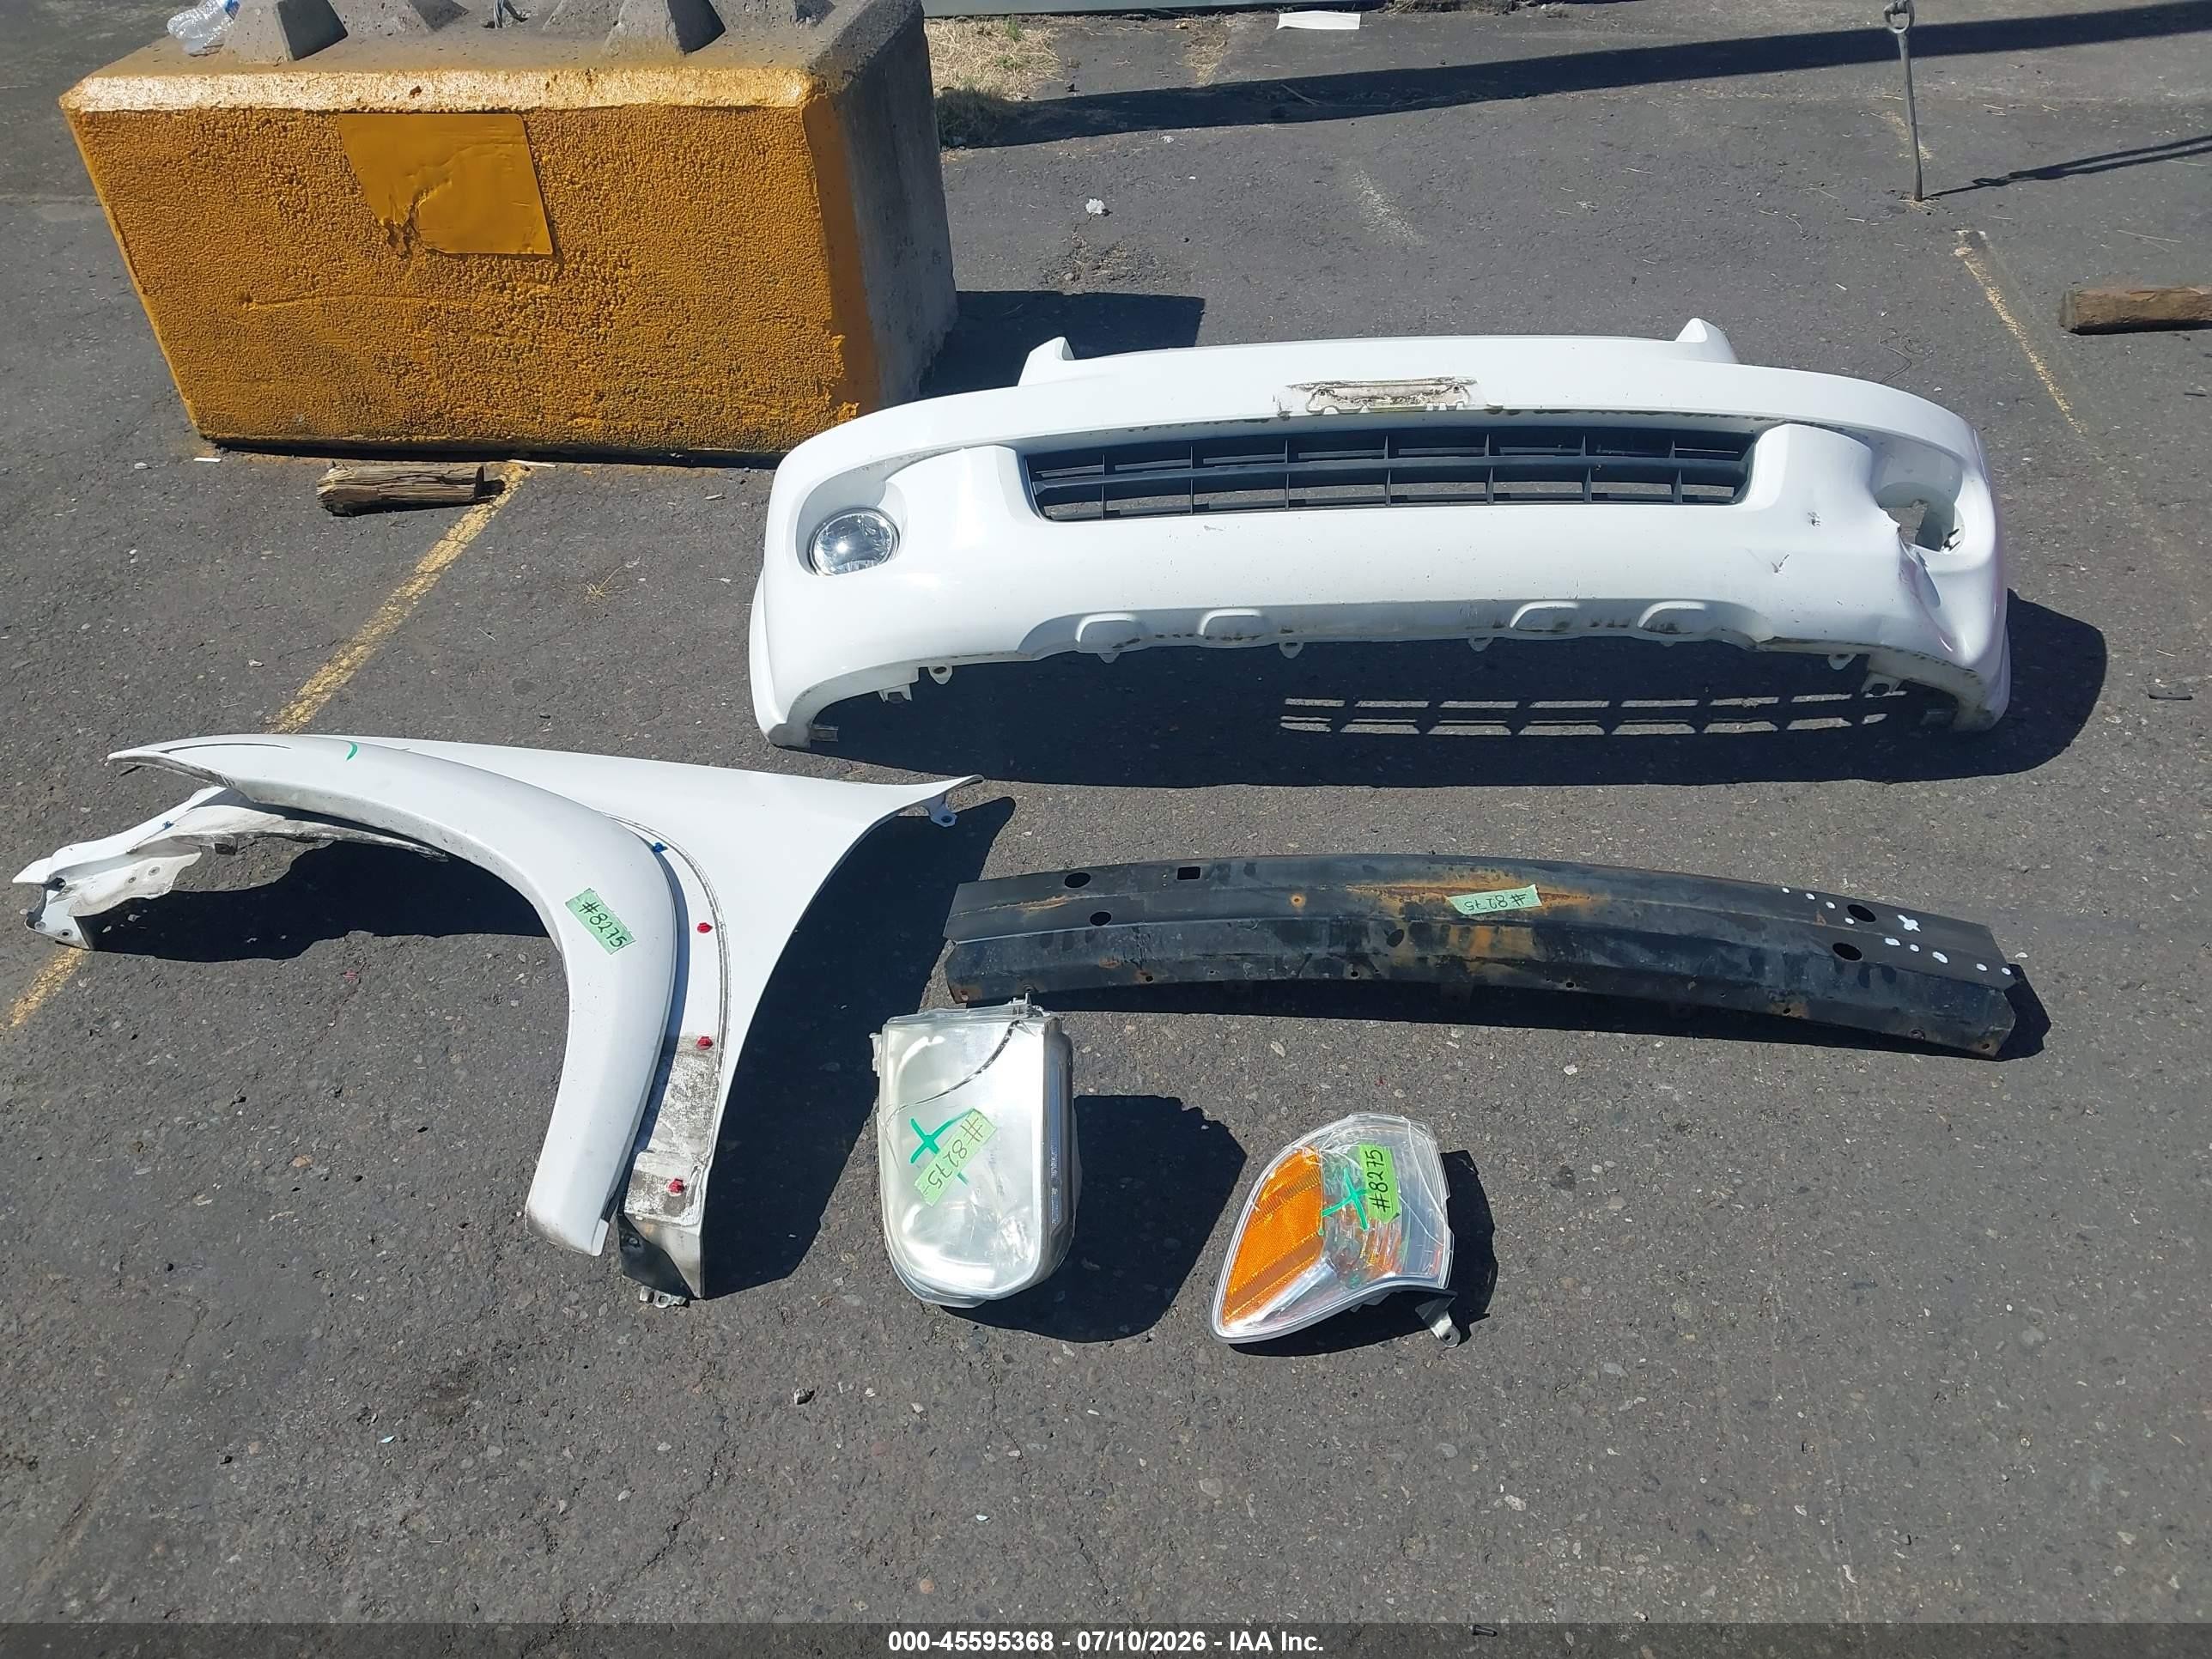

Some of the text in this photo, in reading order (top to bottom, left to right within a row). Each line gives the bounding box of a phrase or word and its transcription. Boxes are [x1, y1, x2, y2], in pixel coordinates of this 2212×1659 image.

[578, 901, 628, 948] #8275
[1464, 893, 1527, 910] #8275
[927, 1116, 984, 1189] #8275
[1364, 1149, 1391, 1212] #8275
